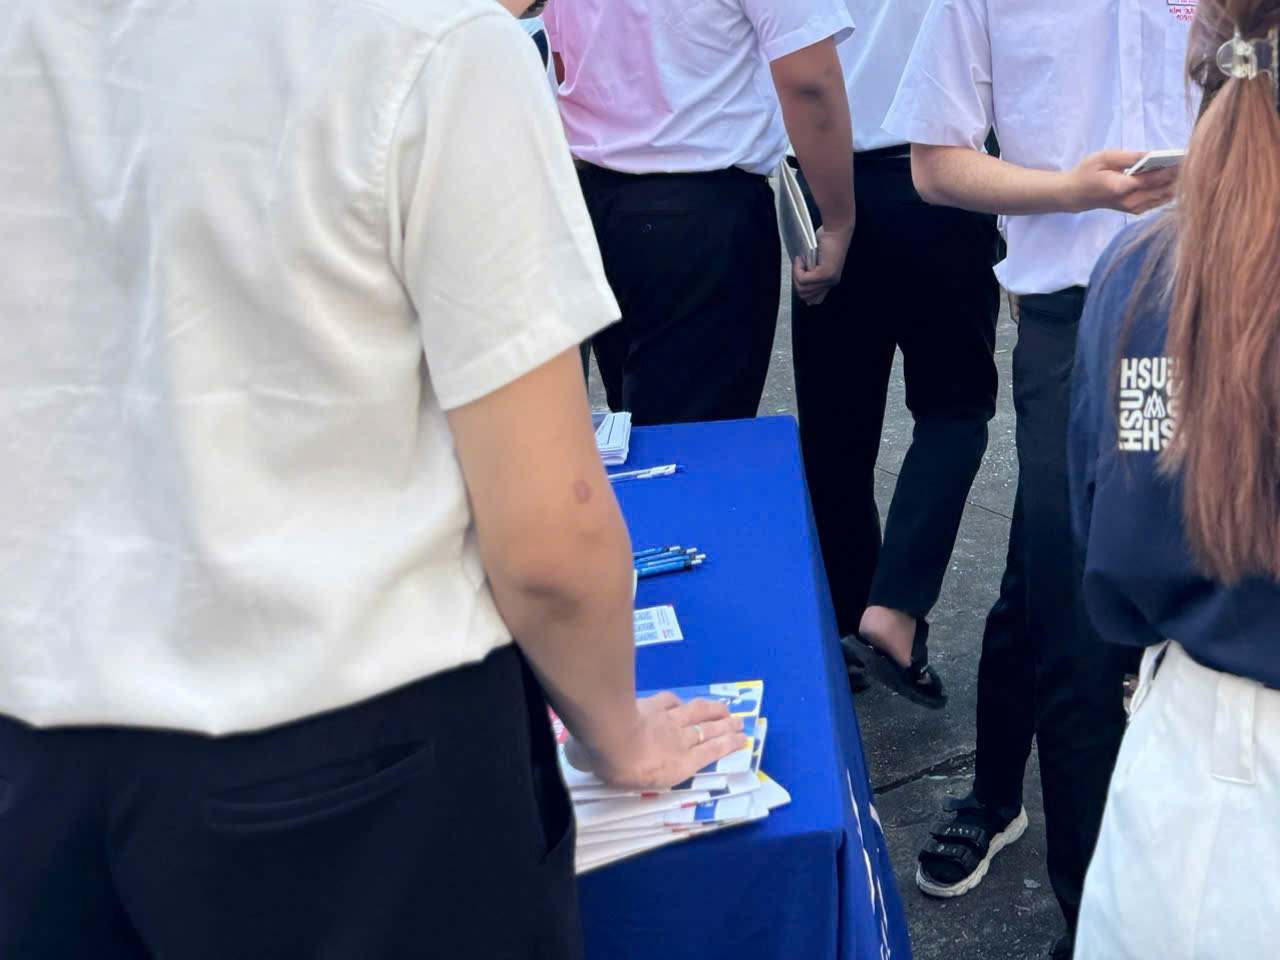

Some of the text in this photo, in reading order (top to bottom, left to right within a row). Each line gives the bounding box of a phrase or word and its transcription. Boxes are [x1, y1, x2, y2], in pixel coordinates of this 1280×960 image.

[1120, 356, 1167, 390] HSU
[1118, 388, 1144, 451] HSU
[1142, 417, 1177, 452] HS
